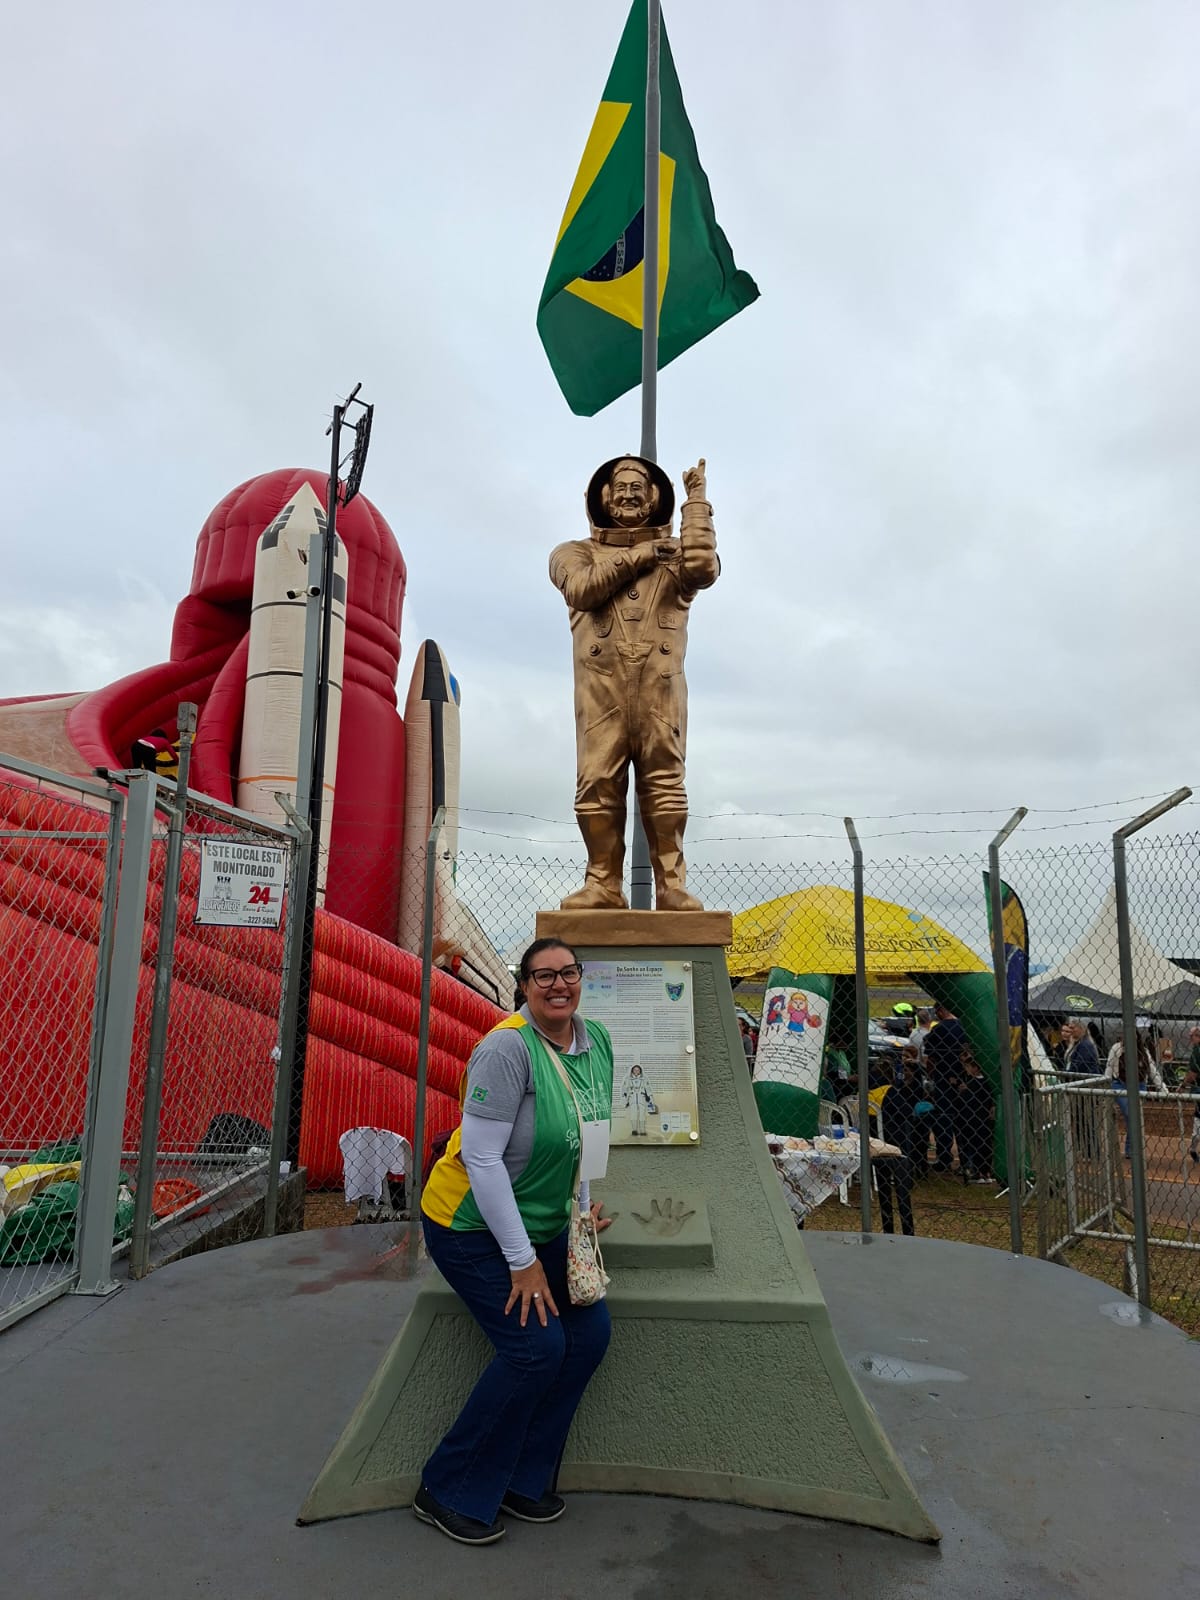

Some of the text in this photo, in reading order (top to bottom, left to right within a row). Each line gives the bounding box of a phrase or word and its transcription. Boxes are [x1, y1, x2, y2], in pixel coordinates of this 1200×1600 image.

[207, 845, 230, 858] ESTE
[232, 847, 259, 862] LOCAL
[213, 861, 275, 878] MONITORADO
[248, 886, 270, 905] 24
